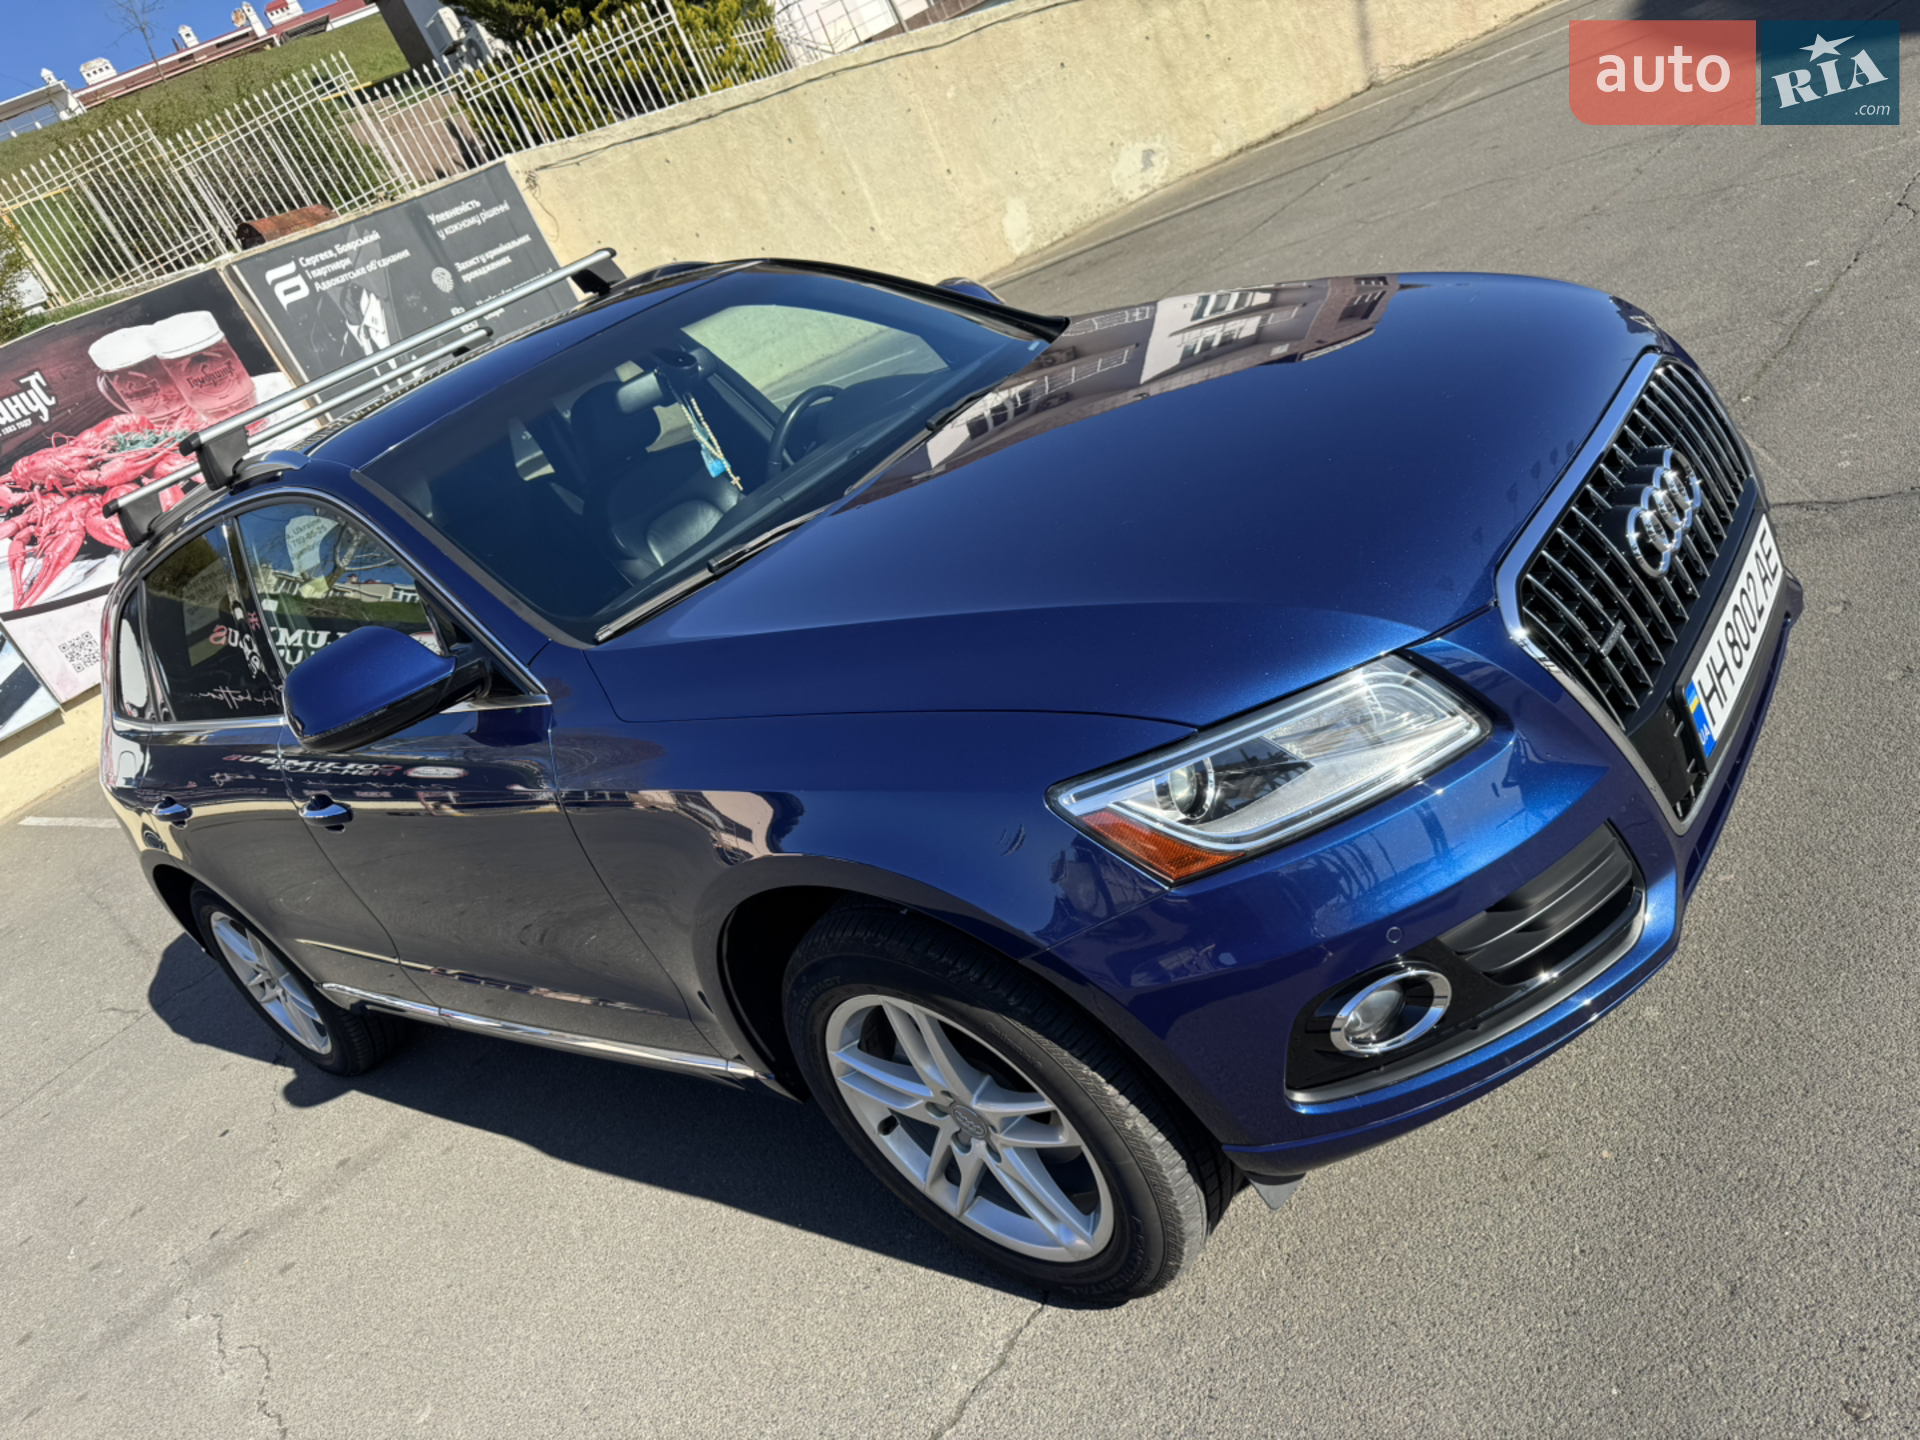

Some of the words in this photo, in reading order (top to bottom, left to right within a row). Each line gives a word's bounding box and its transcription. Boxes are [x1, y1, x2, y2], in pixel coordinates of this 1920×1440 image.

[445, 210, 482, 237] кожному
[479, 199, 511, 225] рішенні
[311, 256, 353, 281] партнери
[313, 263, 369, 294] Адвокатське
[1698, 639, 1735, 726] HH
[1724, 571, 1765, 670] 8002
[1755, 529, 1779, 600] AE
[1700, 723, 1712, 745] UA
